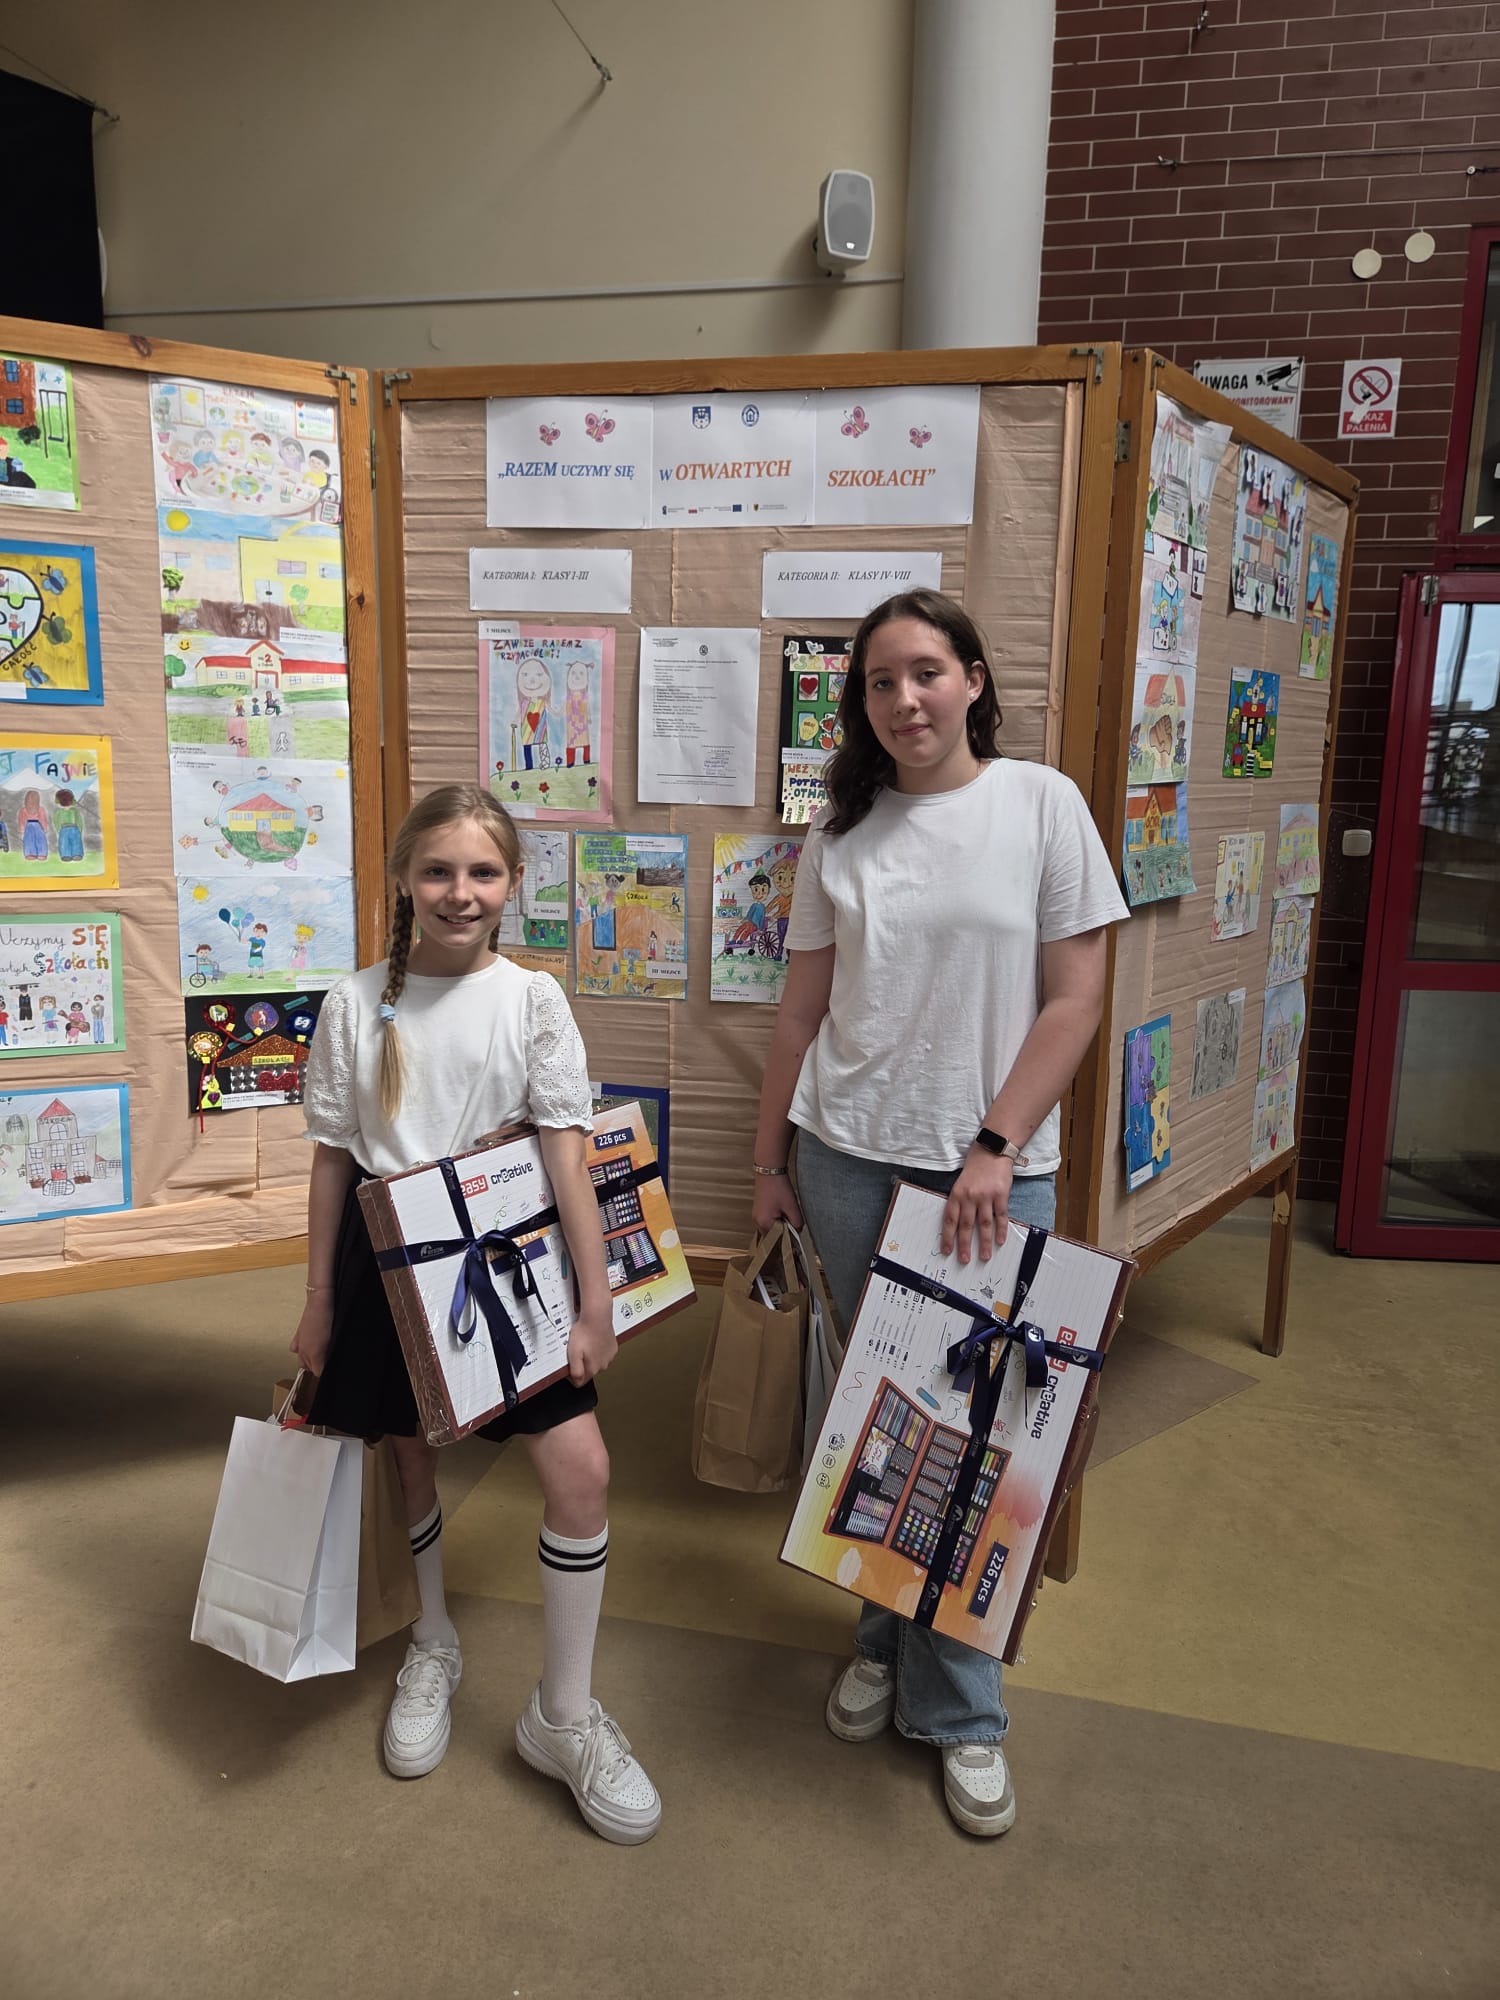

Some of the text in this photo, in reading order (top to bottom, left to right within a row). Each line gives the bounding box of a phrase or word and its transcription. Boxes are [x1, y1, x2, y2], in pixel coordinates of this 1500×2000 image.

[1346, 423, 1388, 432] PALENIA
[561, 464, 612, 477] UCZYMY
[614, 465, 635, 480] SIĘ
[675, 460, 792, 481] OTWARTYCH
[482, 571, 529, 580] KATEGORIA
[541, 570, 571, 580] KLASY
[571, 570, 590, 580] I-III
[777, 571, 829, 581] KATEGORIA
[848, 570, 879, 580] KLASY
[879, 570, 911, 580] IV-VIII
[597, 1132, 627, 1147] 226 pcs
[490, 1162, 534, 1185] creative
[1053, 1330, 1073, 1369] ey
[1030, 1375, 1059, 1440] creative
[977, 1551, 1005, 1603] 226 pcs
